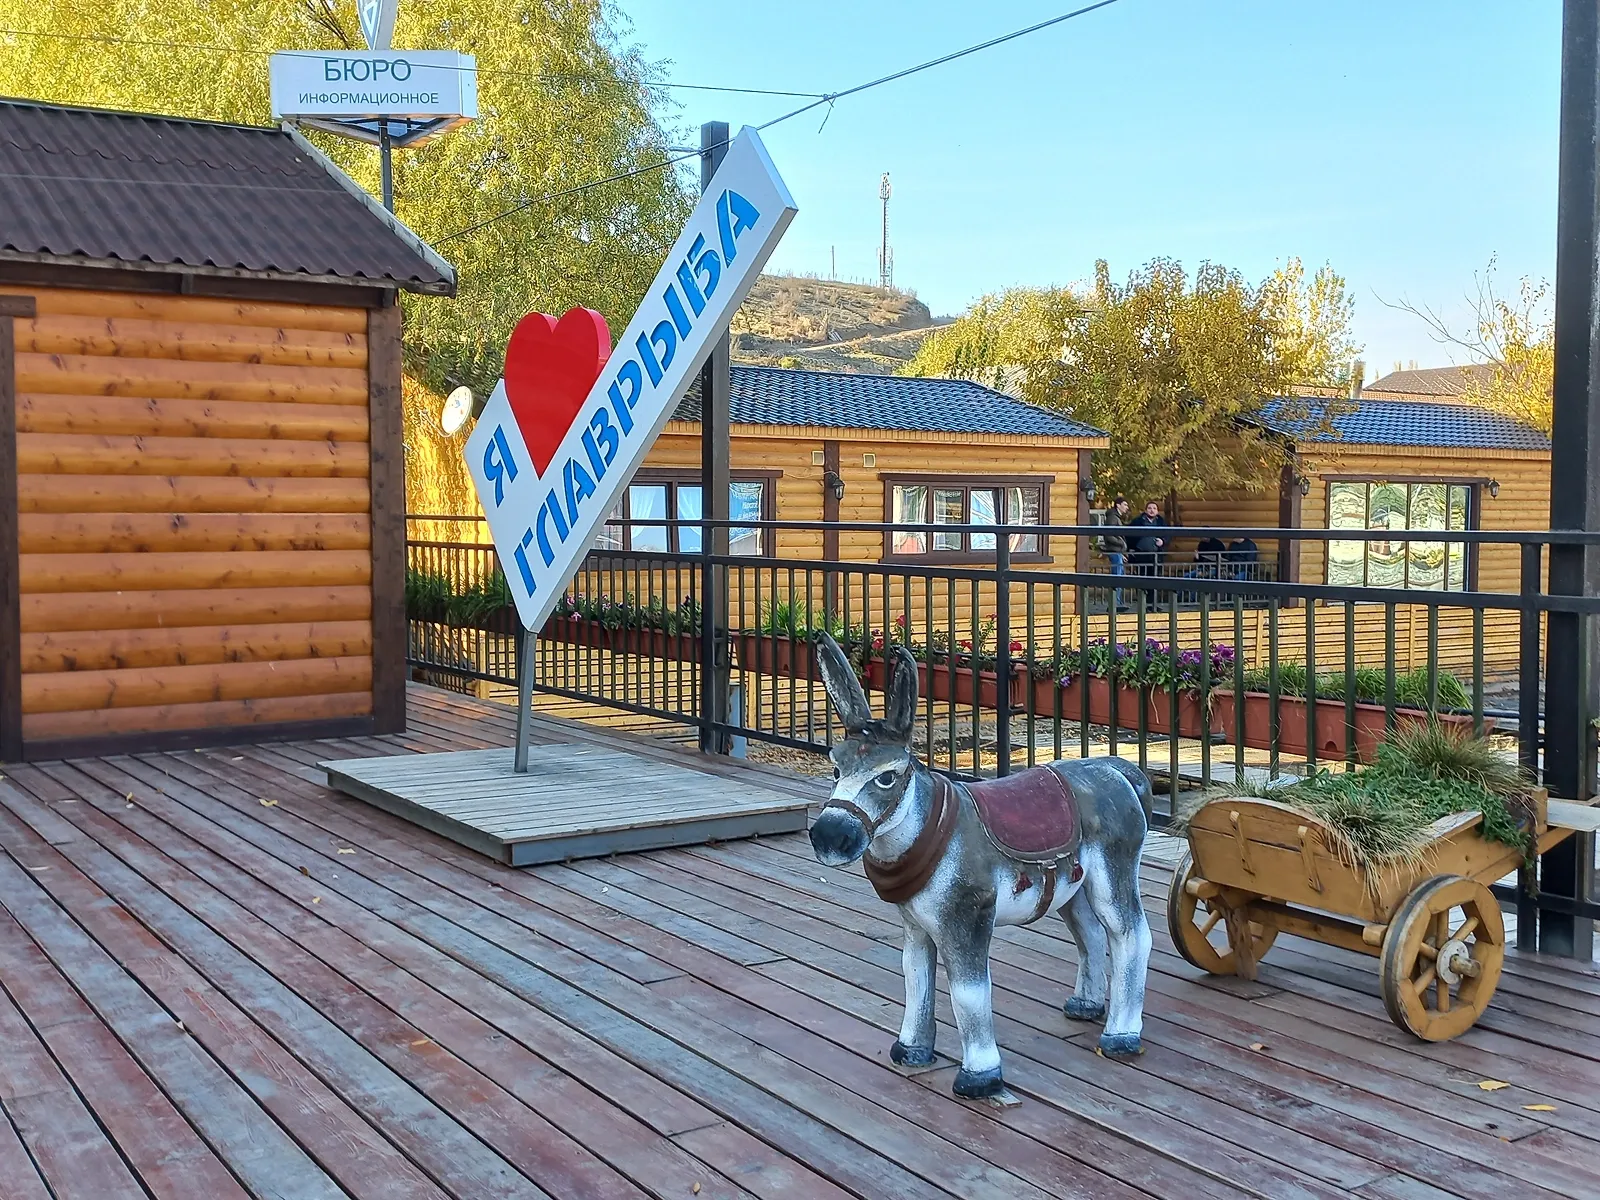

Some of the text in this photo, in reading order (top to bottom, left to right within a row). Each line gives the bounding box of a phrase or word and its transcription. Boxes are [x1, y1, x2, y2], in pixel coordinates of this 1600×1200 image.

[325, 59, 412, 81] БЮРО
[299, 92, 439, 106] ИНФОРМАЦИОННОЕ
[514, 189, 761, 599] ГЛАВРЫБА
[483, 424, 519, 507] Я
